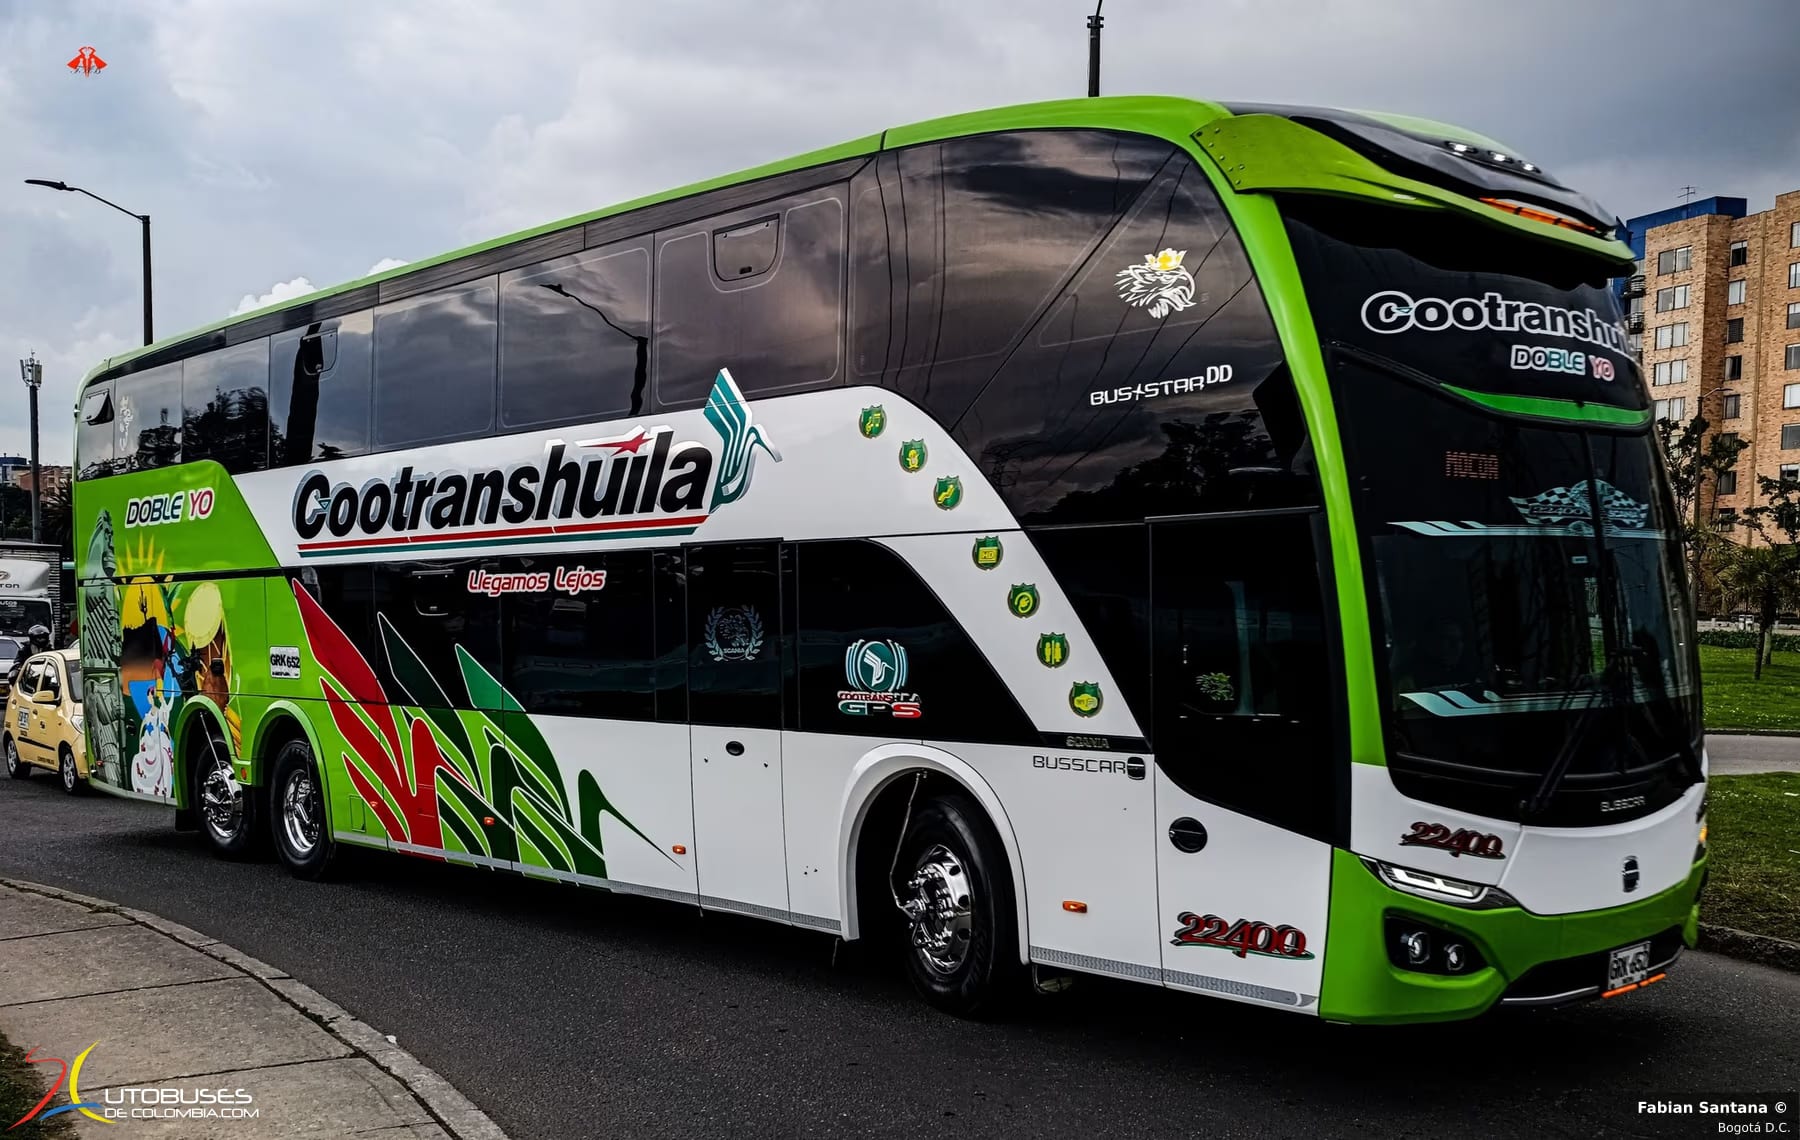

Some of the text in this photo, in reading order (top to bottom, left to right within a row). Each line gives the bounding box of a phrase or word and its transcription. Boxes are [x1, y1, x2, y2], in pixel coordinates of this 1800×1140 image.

[1206, 364, 1233, 385] DD
[1511, 345, 1615, 381] DOBLE YO
[293, 428, 713, 540] Cootranshuila
[125, 487, 215, 528] DOBLE YO
[468, 565, 606, 597] Llegamos Lejos
[270, 654, 300, 669] GRK 652
[838, 700, 921, 718] GPS
[1033, 755, 1126, 774] BUSSCAR
[1400, 821, 1504, 858] 22400
[1173, 911, 1308, 959] 22400
